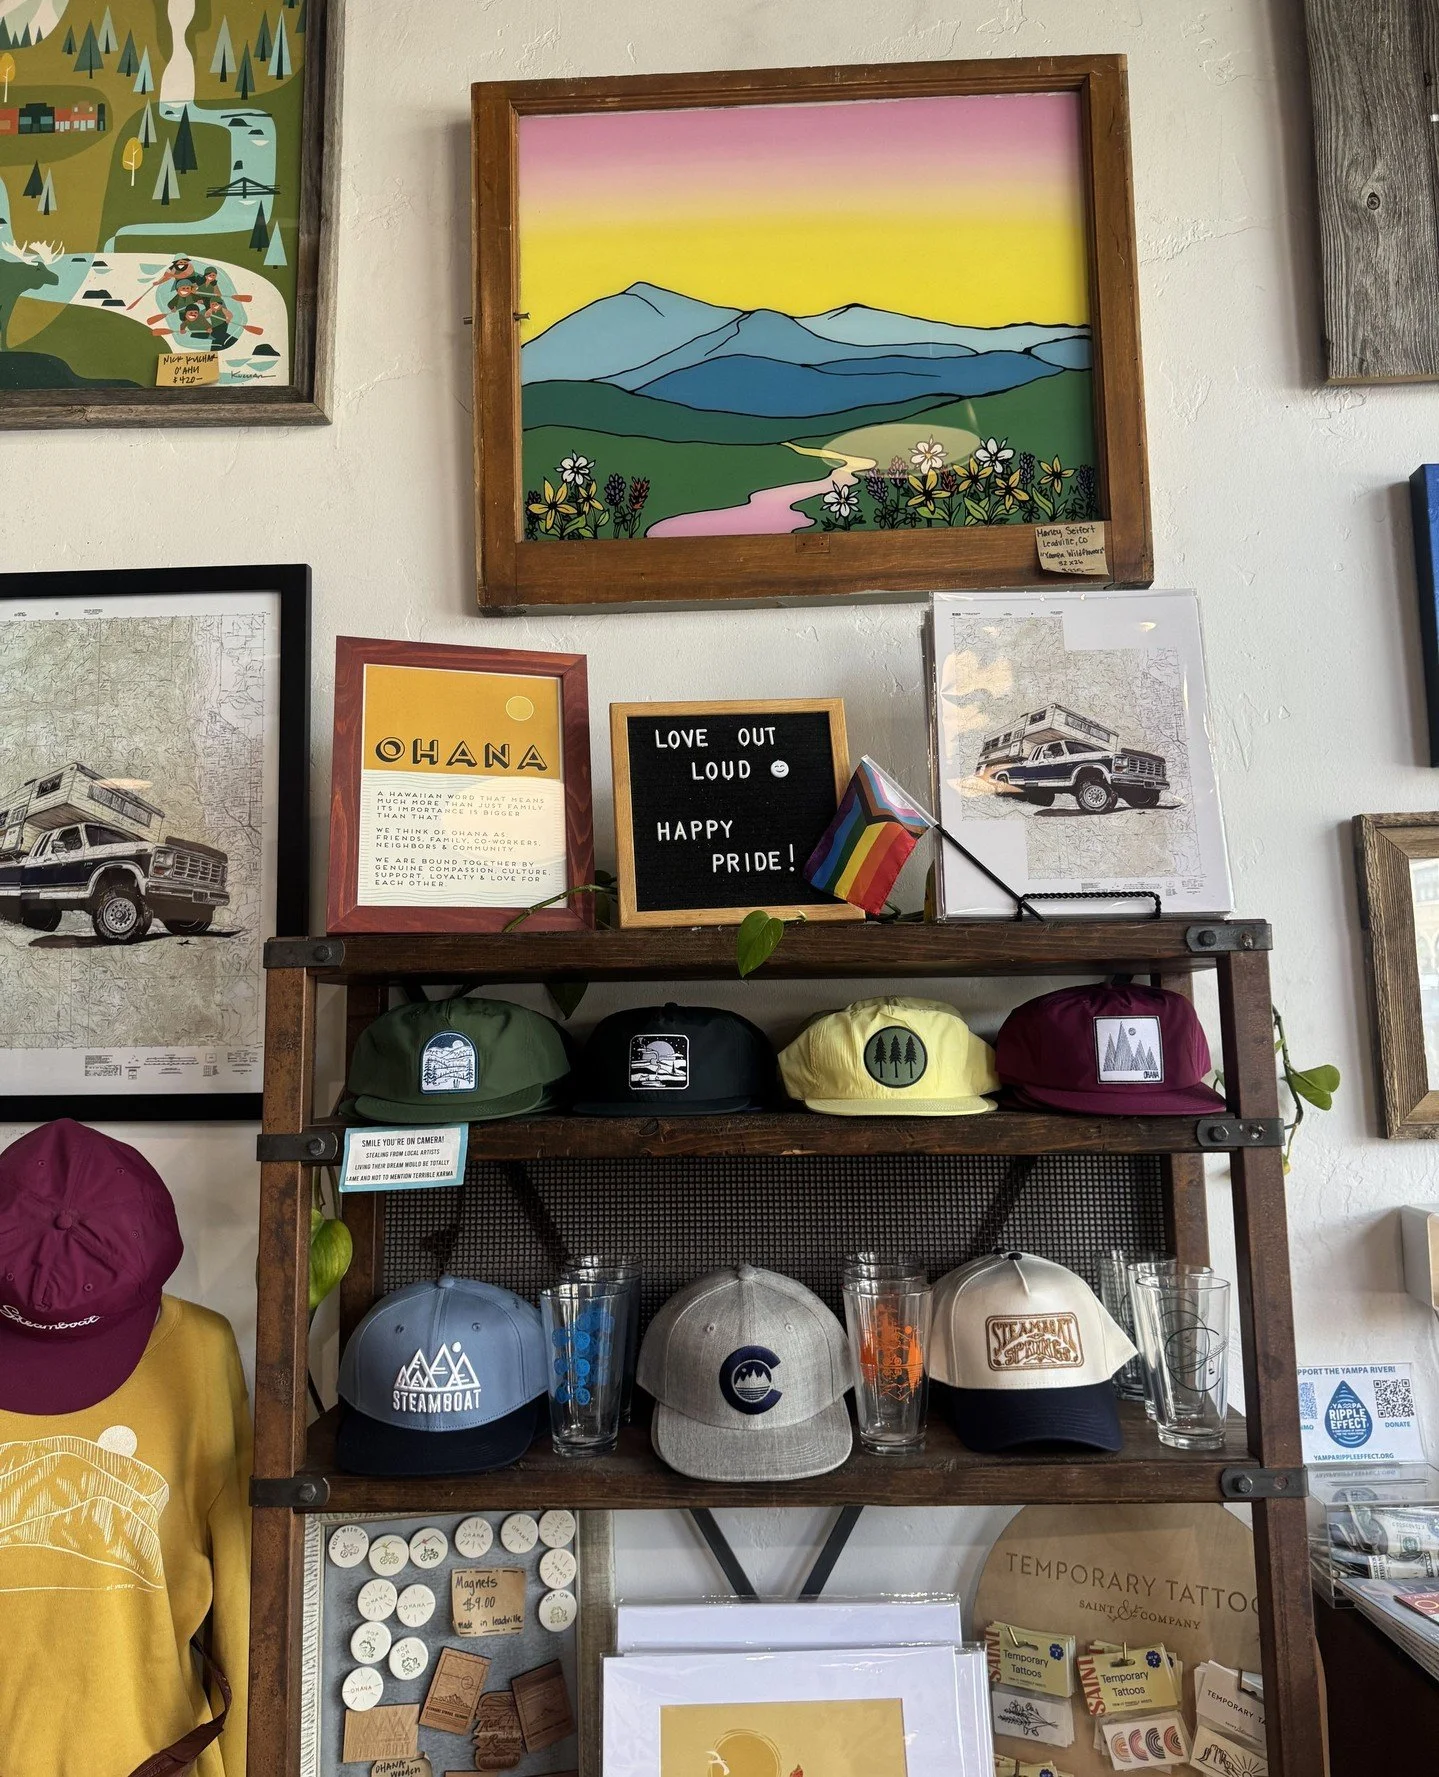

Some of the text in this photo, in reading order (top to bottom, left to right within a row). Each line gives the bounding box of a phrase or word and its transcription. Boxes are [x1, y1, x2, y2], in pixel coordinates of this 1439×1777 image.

[655, 727, 776, 749] LOVE OUT
[375, 736, 548, 771] OHANA
[691, 760, 751, 780] LOUD
[389, 791, 442, 799] HAWAIIAN
[398, 806, 464, 815] IMPORTANCE
[657, 820, 733, 841] HAPPY
[376, 842, 437, 850] NEIGHBORS
[375, 864, 424, 872] GENUINE
[463, 859, 517, 867] TOGETHER
[429, 873, 474, 881] LOYALTY
[361, 1139, 381, 1148] SMILE
[406, 1137, 415, 1145] ON
[416, 1135, 445, 1145] CAMERA!
[366, 1151, 389, 1159] STEALING
[420, 1148, 440, 1156] ARTISTS
[371, 1162, 386, 1170] THEIR
[386, 1161, 404, 1169] DREAM
[430, 1159, 450, 1167] TOTALLY
[389, 1172, 411, 1180] MENTION
[412, 1171, 435, 1179] TERRIBLE
[436, 1170, 453, 1178] KARMA
[1297, 1365, 1396, 1376] PPORT THE YAMPA RIVER!
[392, 1388, 481, 1413] STEAMBOAT
[1329, 1409, 1367, 1420] RIPPLE
[1331, 1418, 1367, 1430] EFFECT
[455, 1575, 498, 1596] Magnets
[1006, 1552, 1259, 1613] TEMPORARY TATTO
[463, 1596, 496, 1612] $9.00
[1079, 1600, 1115, 1614] SAINT
[1140, 1611, 1201, 1630] COMPANY
[1002, 1649, 1049, 1668] Temporary
[1011, 1663, 1042, 1678] Tattoos
[1101, 1671, 1149, 1684] Temporary
[1112, 1686, 1146, 1697] Tattoos
[1207, 1689, 1254, 1718] TEMPORARY
